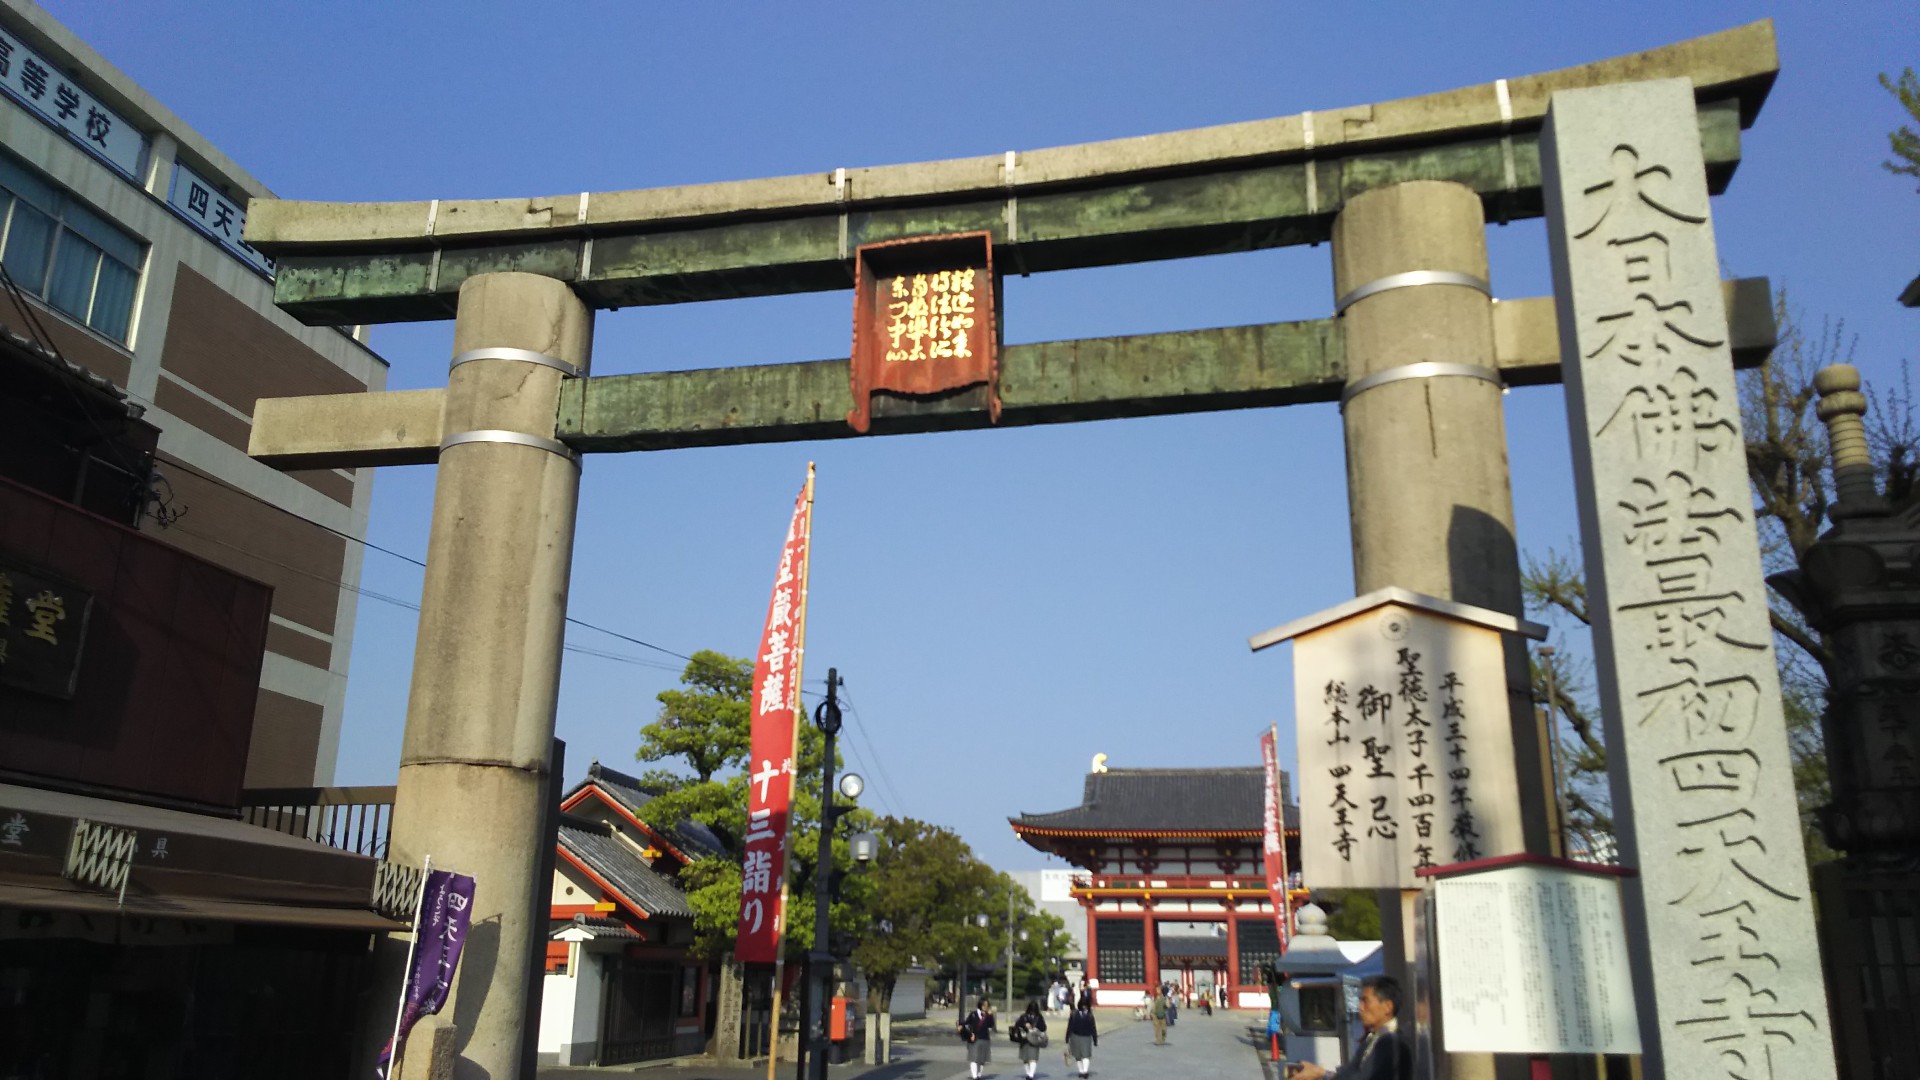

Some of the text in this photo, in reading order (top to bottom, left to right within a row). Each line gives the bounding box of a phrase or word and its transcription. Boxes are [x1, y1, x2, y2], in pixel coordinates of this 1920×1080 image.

[1329, 765, 1358, 862] 四天王寺
[1357, 684, 1399, 840] 御聖忌
[743, 760, 779, 934] 十三詣り
